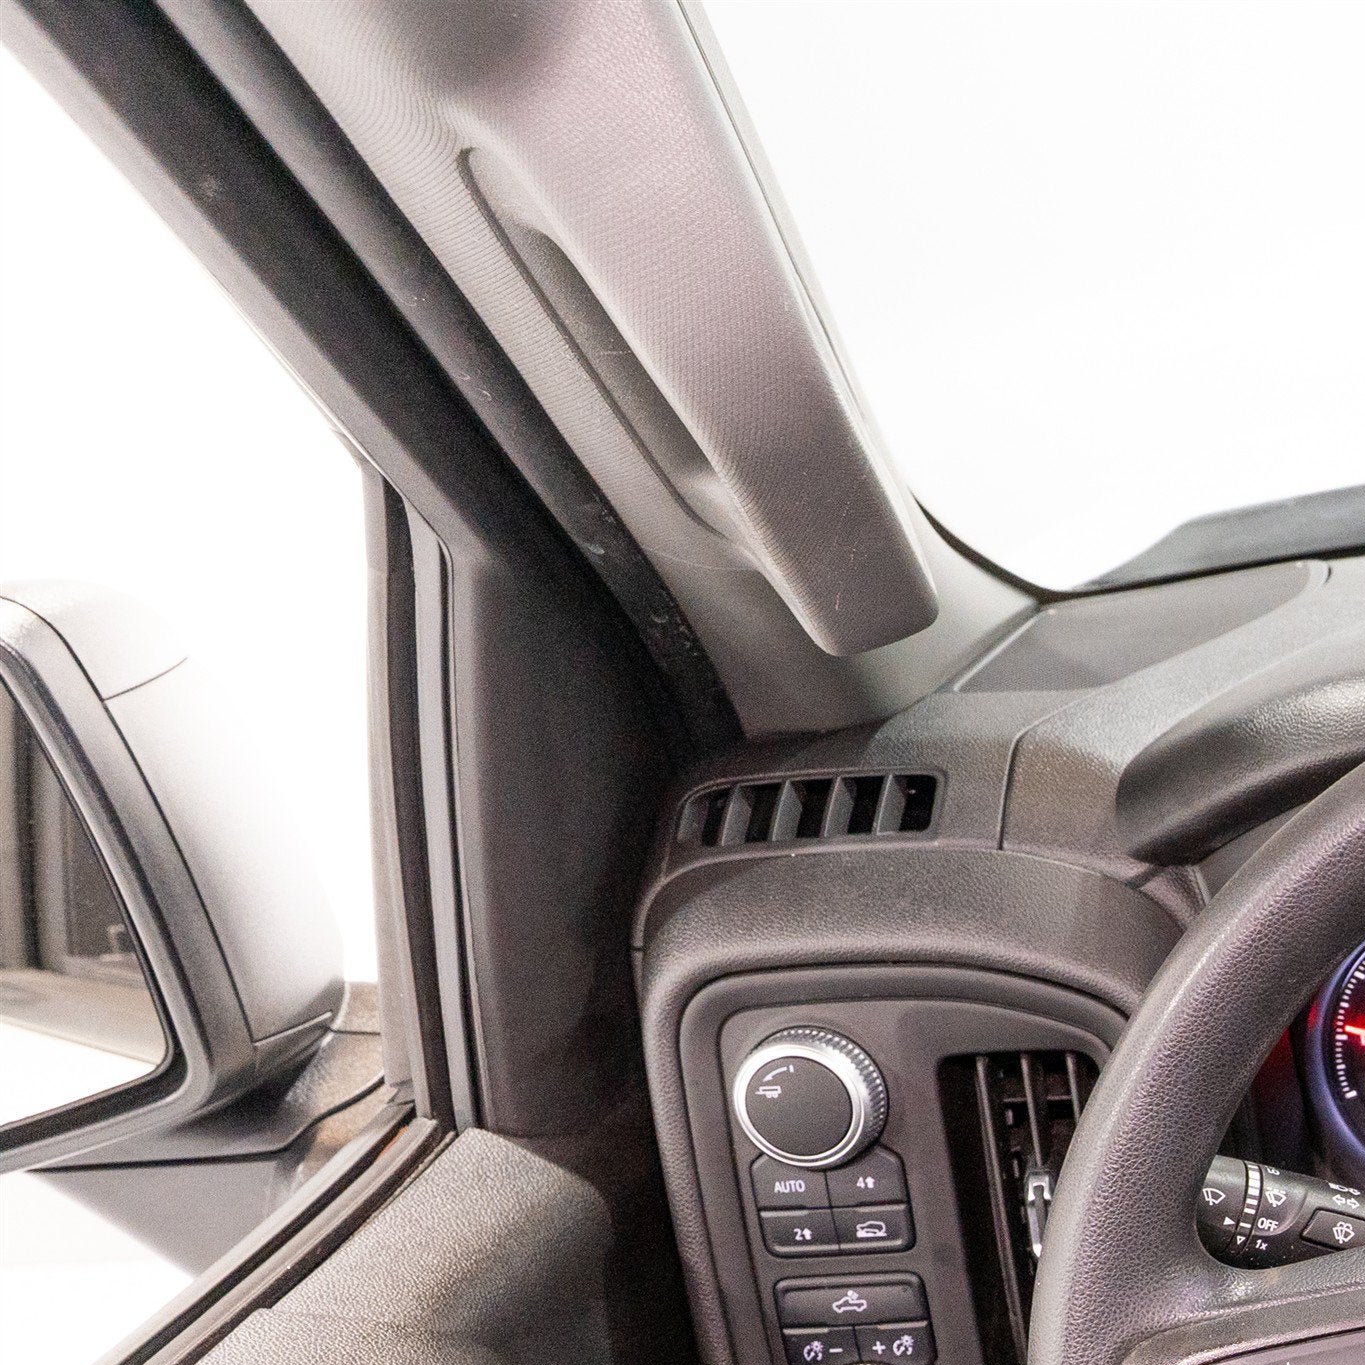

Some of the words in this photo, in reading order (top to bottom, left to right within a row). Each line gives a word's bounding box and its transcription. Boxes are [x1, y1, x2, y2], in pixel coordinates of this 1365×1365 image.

[773, 1181, 806, 1194] AUTO
[1257, 1217, 1279, 1232] OFF
[1255, 1239, 1269, 1251] 1x
